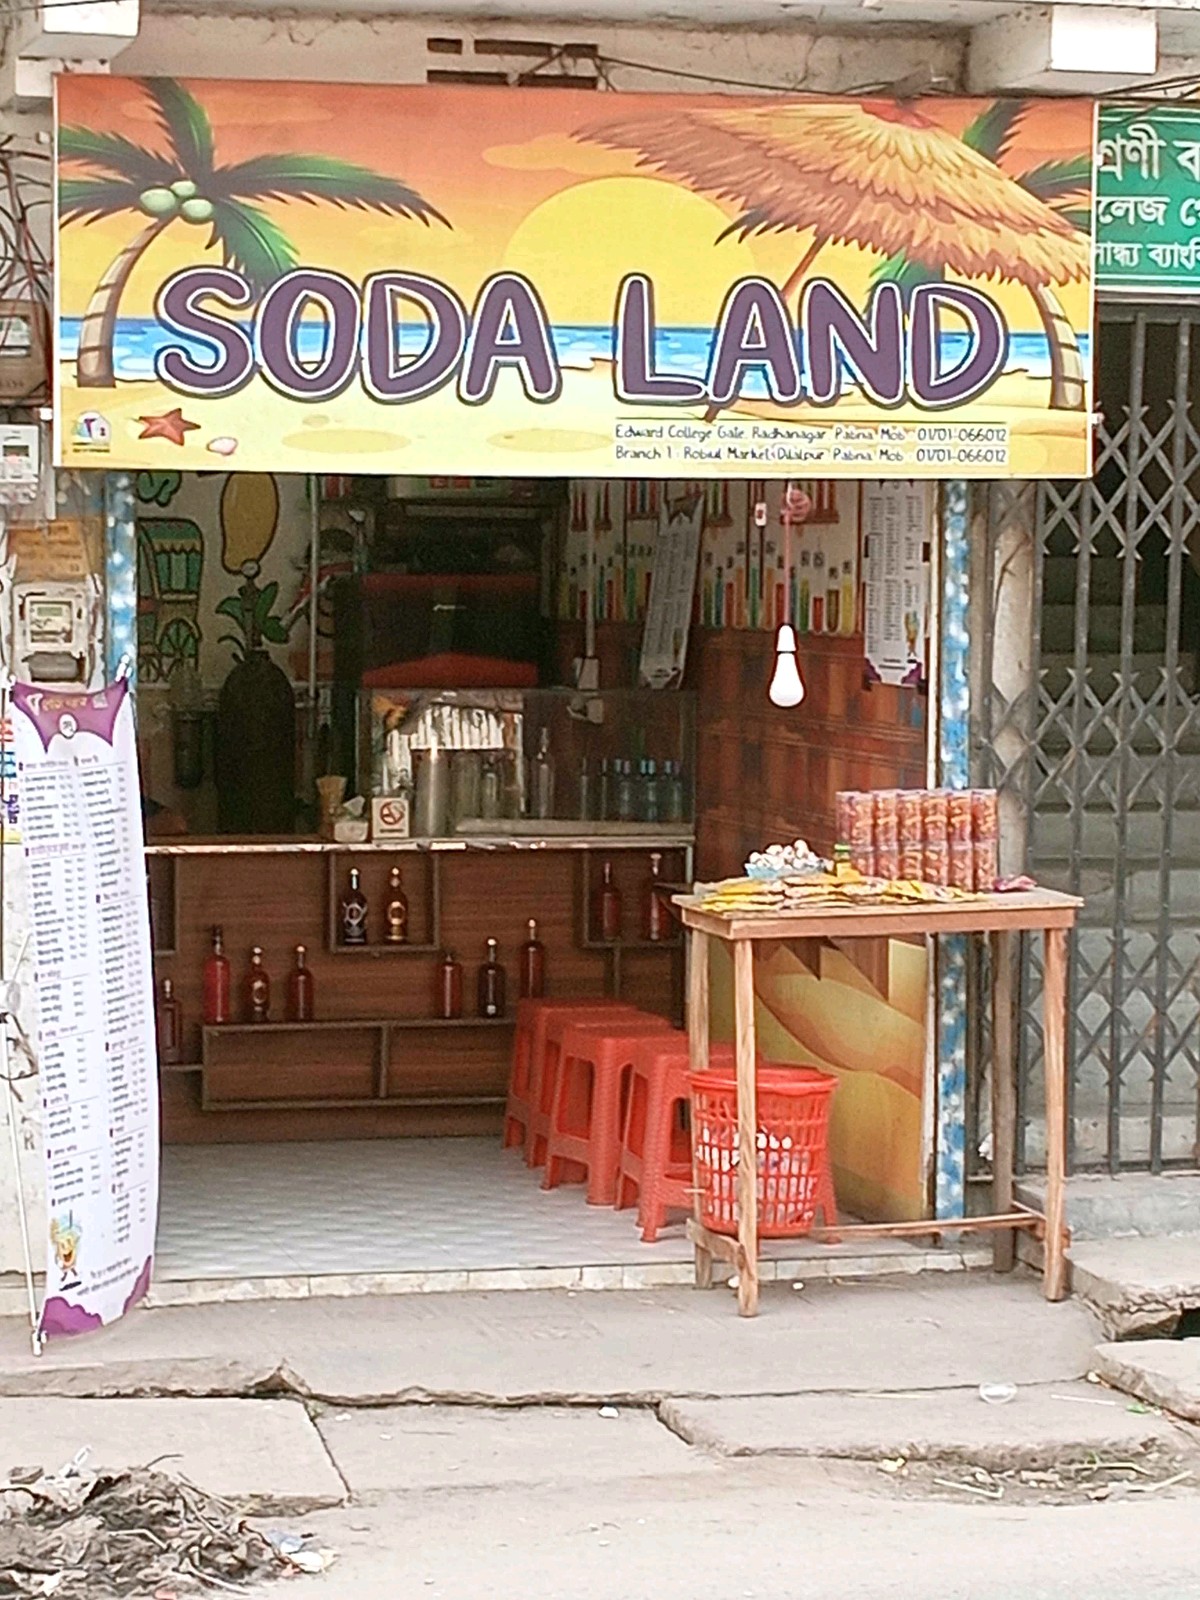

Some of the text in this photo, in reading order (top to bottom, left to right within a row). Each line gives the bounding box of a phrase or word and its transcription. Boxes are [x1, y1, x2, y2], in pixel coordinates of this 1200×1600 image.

[1097, 124, 1168, 182] গ্রণী
[1096, 195, 1171, 226] লেজ
[154, 266, 1009, 412] SODA LAND
[615, 424, 663, 439] Edward
[667, 424, 712, 443] College
[615, 446, 662, 460] Branch
